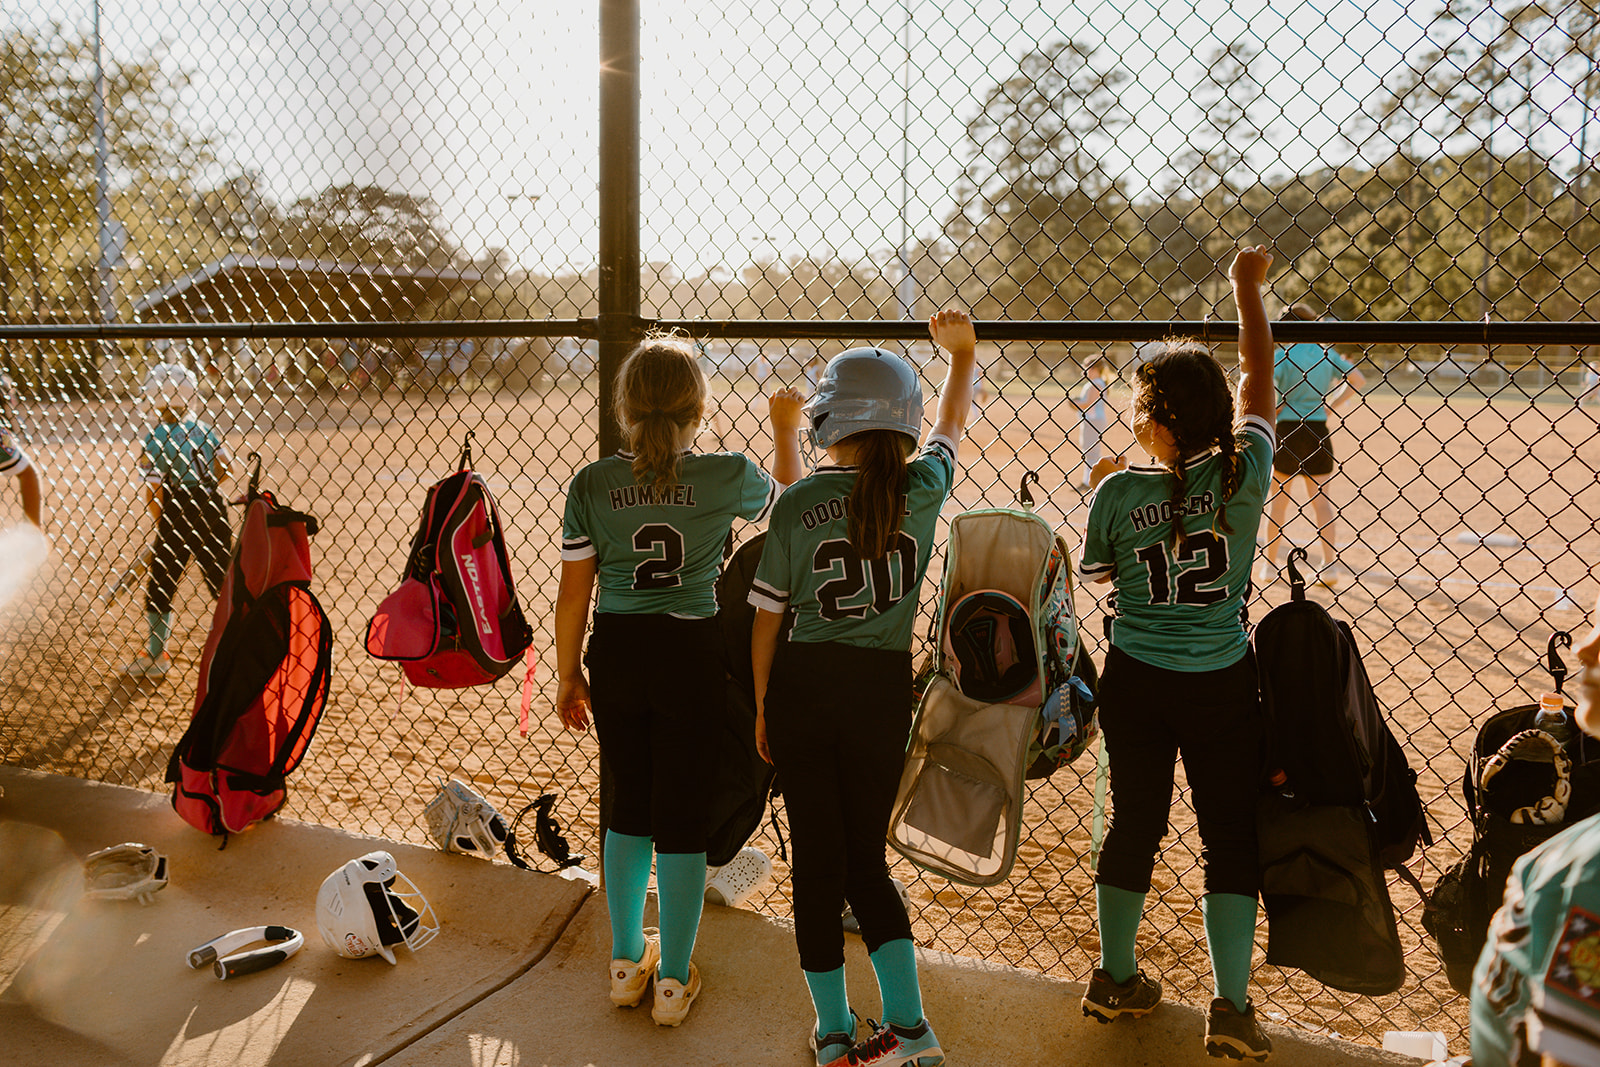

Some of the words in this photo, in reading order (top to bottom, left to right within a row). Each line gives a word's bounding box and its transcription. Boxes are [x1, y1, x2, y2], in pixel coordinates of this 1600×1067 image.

[609, 484, 696, 511] HUMMEL
[631, 523, 685, 590] 2
[812, 530, 918, 621] 20
[1133, 529, 1230, 607] 12
[461, 554, 493, 635] EASTON
[848, 1030, 899, 1066] NIKE
